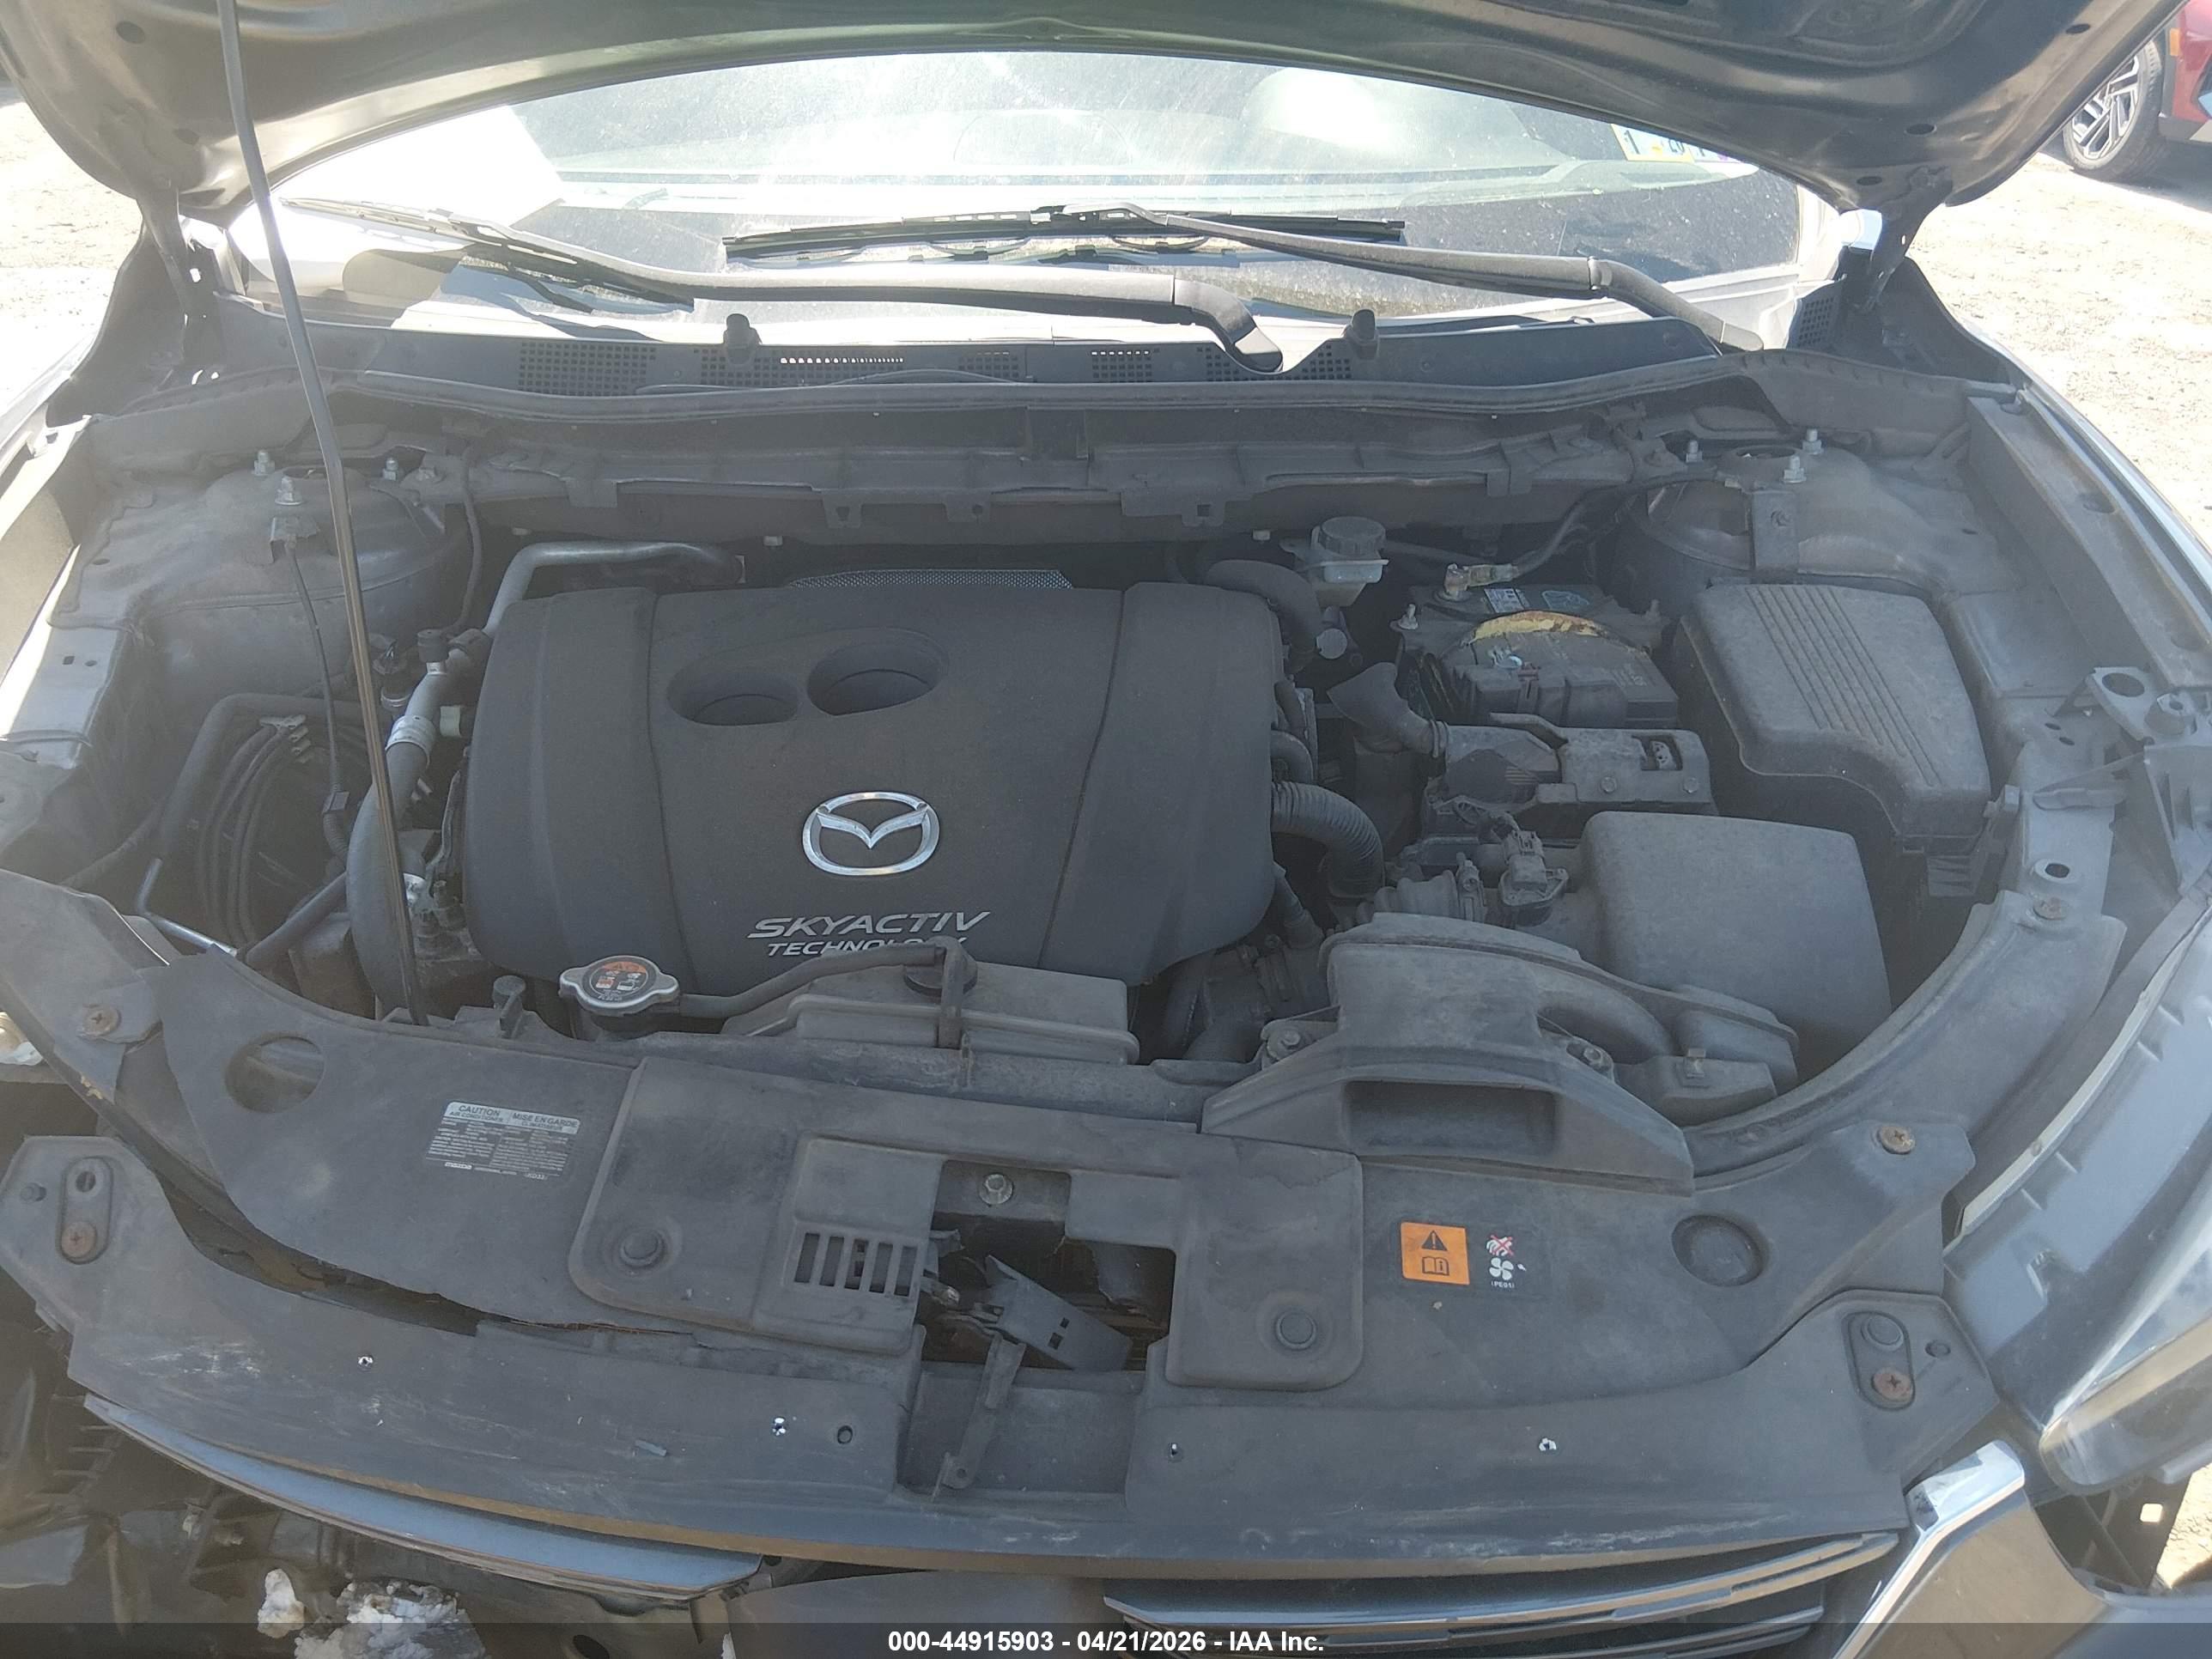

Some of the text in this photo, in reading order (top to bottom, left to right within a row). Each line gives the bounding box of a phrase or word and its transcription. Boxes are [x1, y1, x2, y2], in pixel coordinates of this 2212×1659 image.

[747, 911, 991, 938] SKYACTIV
[459, 1105, 501, 1116] CAUTION
[512, 1112, 533, 1121] MISE
[547, 1117, 578, 1128] GARDE
